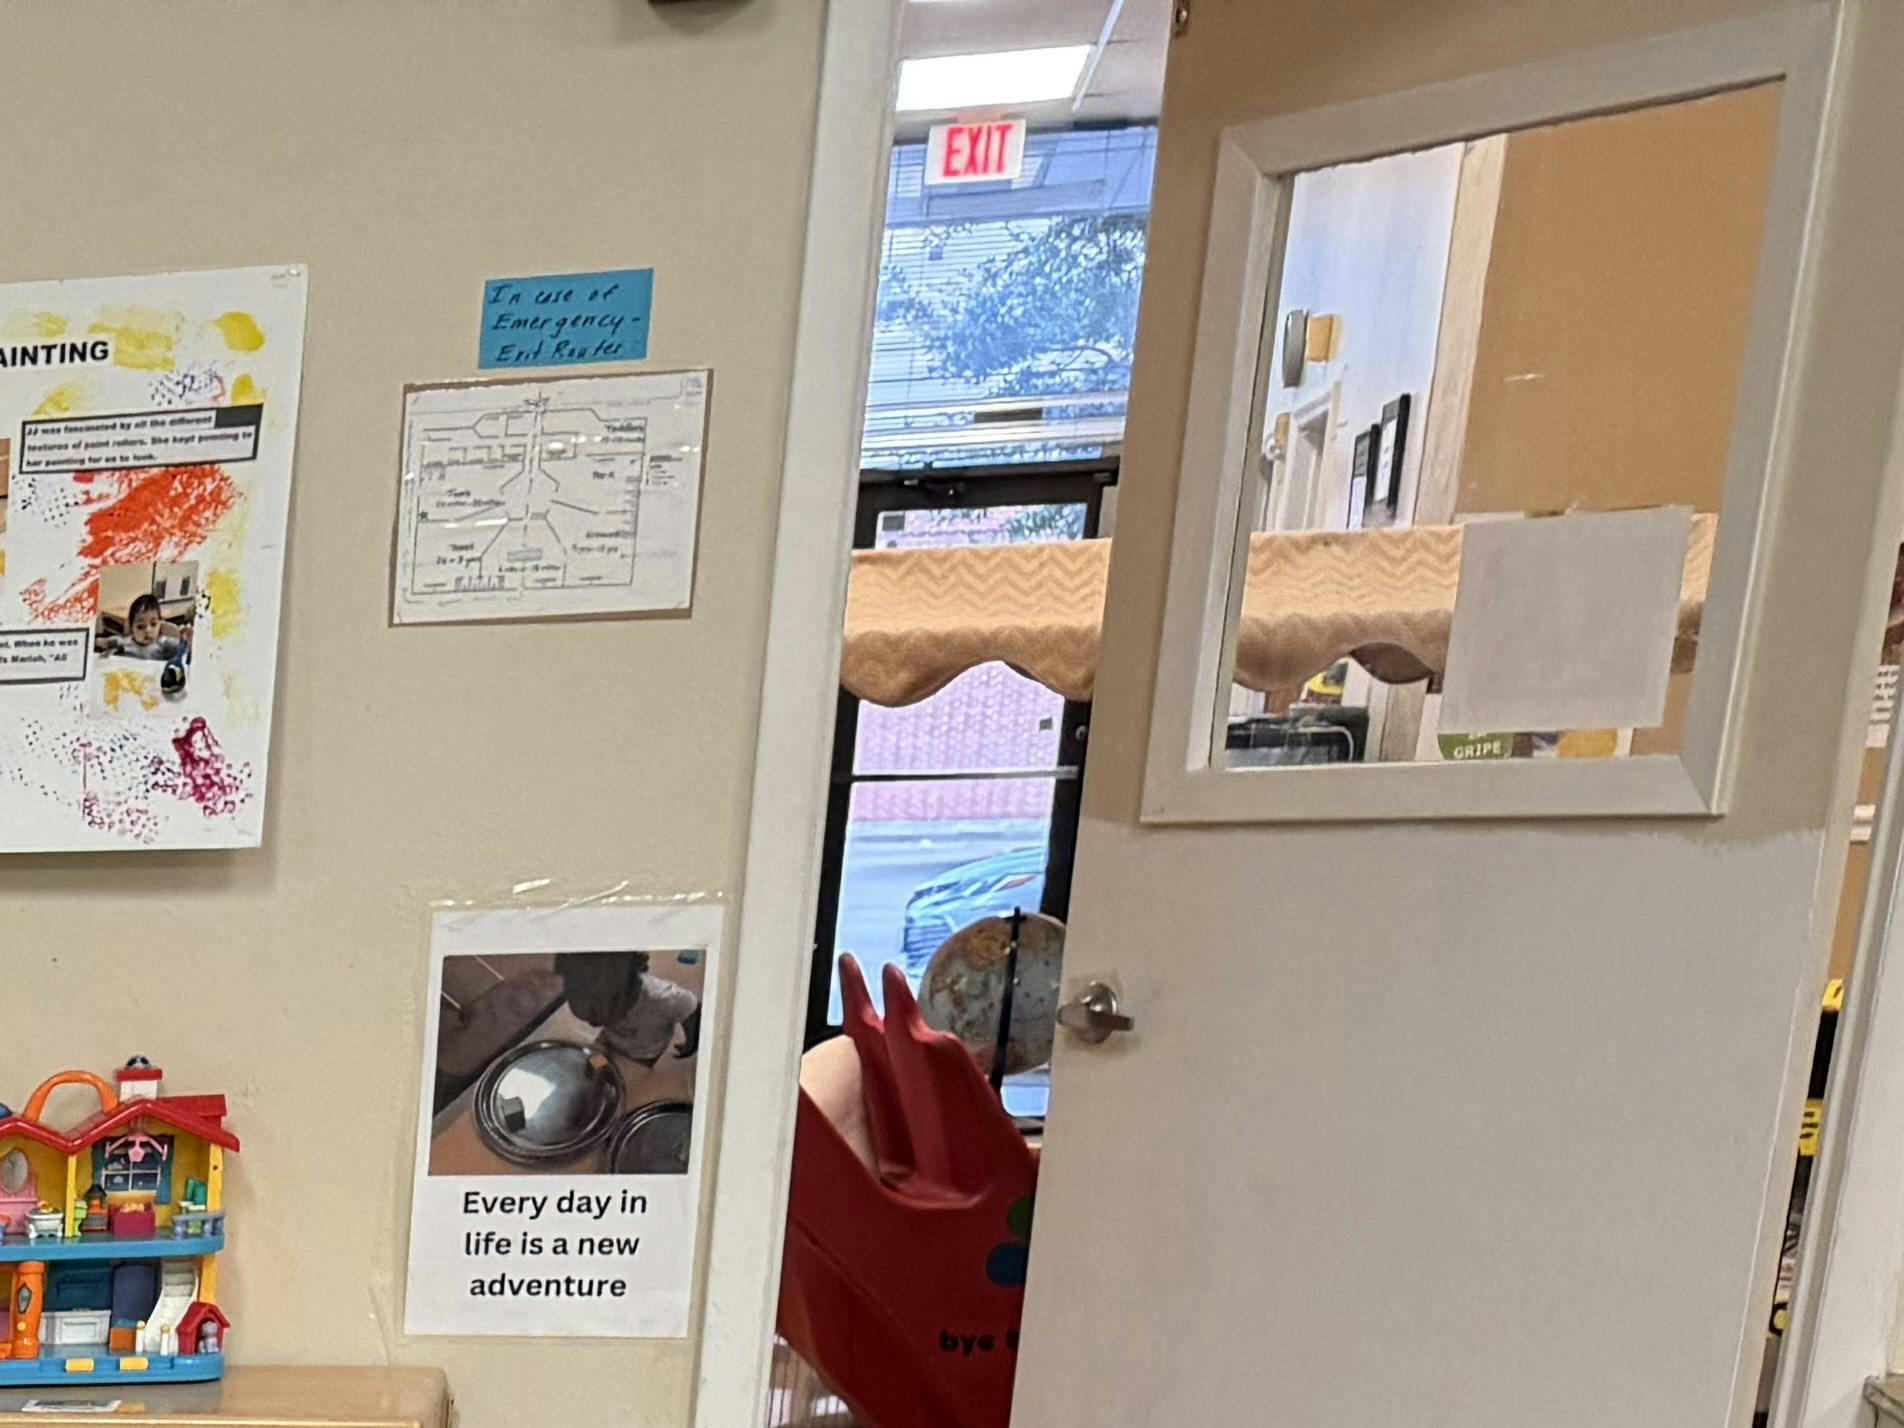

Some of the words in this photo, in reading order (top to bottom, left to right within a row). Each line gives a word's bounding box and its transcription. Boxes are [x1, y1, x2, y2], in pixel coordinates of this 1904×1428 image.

[943, 124, 1013, 177] EXIT
[488, 283, 522, 305] In
[535, 288, 574, 305] case
[588, 283, 620, 303] of
[496, 340, 545, 362] Exit
[552, 339, 623, 360] Routes
[41, 426, 61, 435] was
[63, 421, 117, 434] fascinated
[119, 421, 132, 431] by
[134, 420, 147, 429] all
[149, 418, 166, 428] the
[168, 415, 212, 427] different
[27, 442, 69, 452] textures
[71, 439, 83, 450] of
[84, 440, 110, 450] paint
[151, 436, 169, 445] She
[173, 435, 196, 445] kept
[87, 455, 103, 464] for
[43, 639, 55, 647] he
[462, 1190, 548, 1220] Every
[556, 1189, 612, 1220] day
[620, 1188, 648, 1214] in
[464, 1231, 513, 1256] life
[520, 1230, 544, 1256] is
[552, 1237, 569, 1256] a
[577, 1237, 640, 1256] new
[469, 1271, 627, 1297] adventure
[939, 1326, 996, 1357] bye
